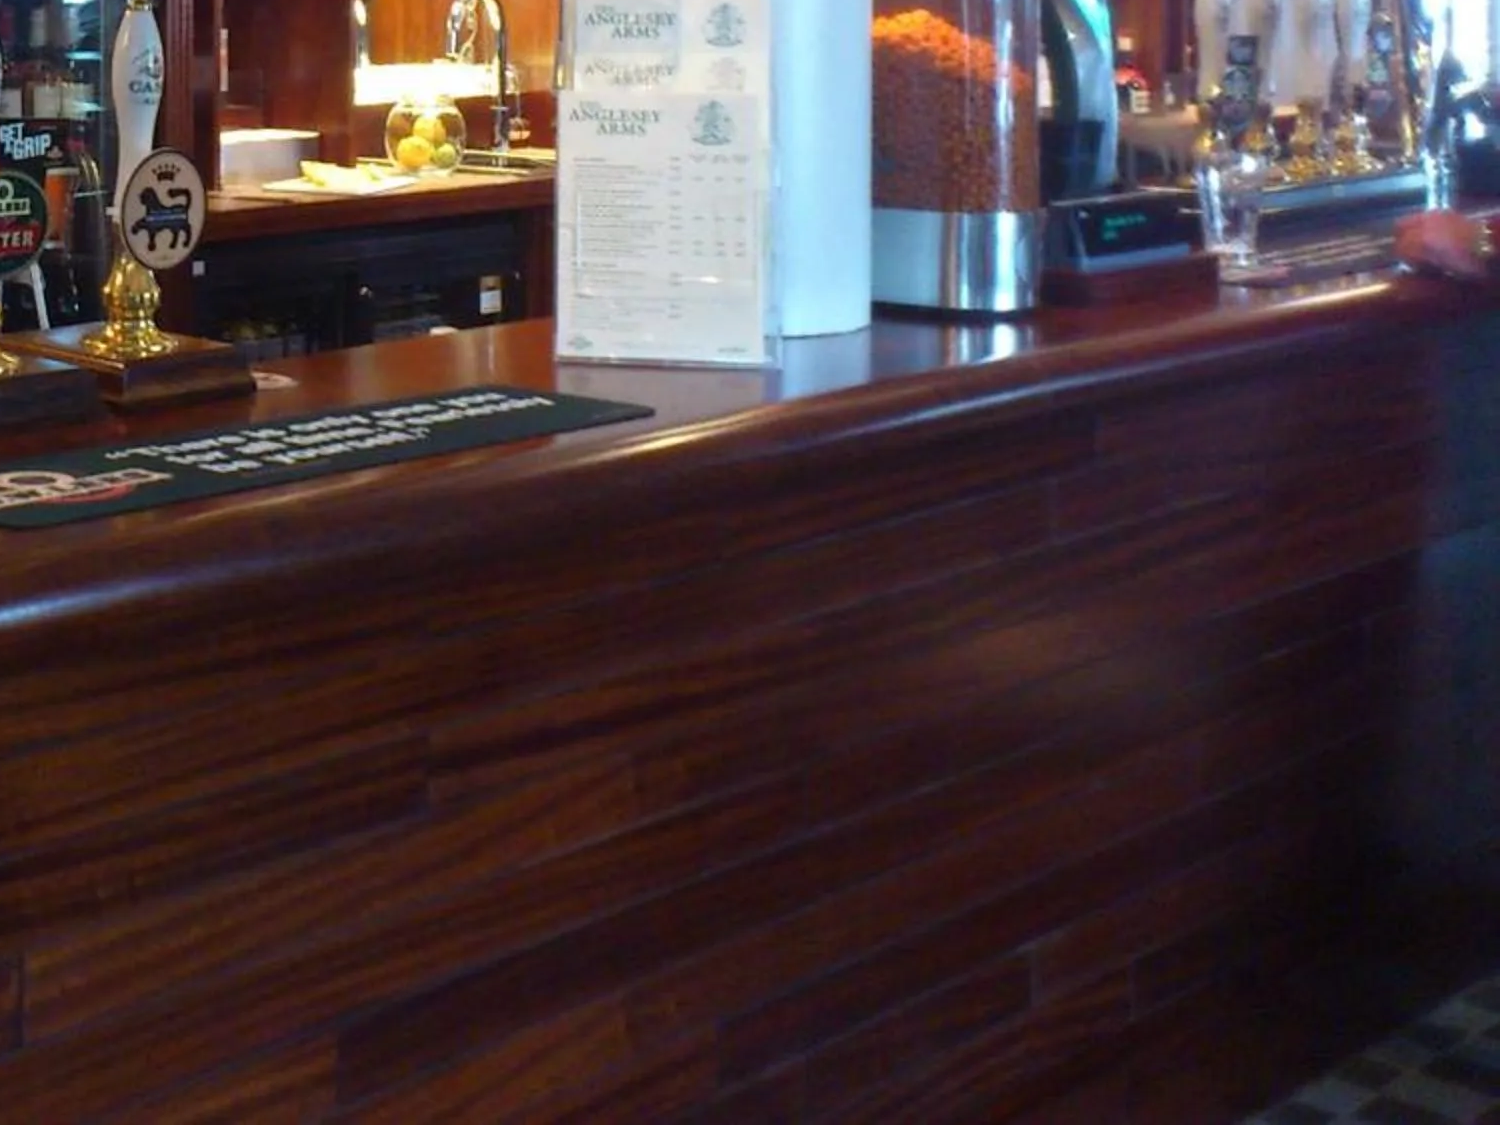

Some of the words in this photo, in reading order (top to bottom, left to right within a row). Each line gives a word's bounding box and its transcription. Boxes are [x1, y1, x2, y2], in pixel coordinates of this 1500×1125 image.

[584, 12, 677, 26] ANGLESEY
[611, 26, 660, 39] ARMS
[569, 108, 661, 123] ANGLESEY
[0, 123, 24, 143] GET
[596, 122, 647, 135] ARMS
[13, 133, 51, 160] GRIP
